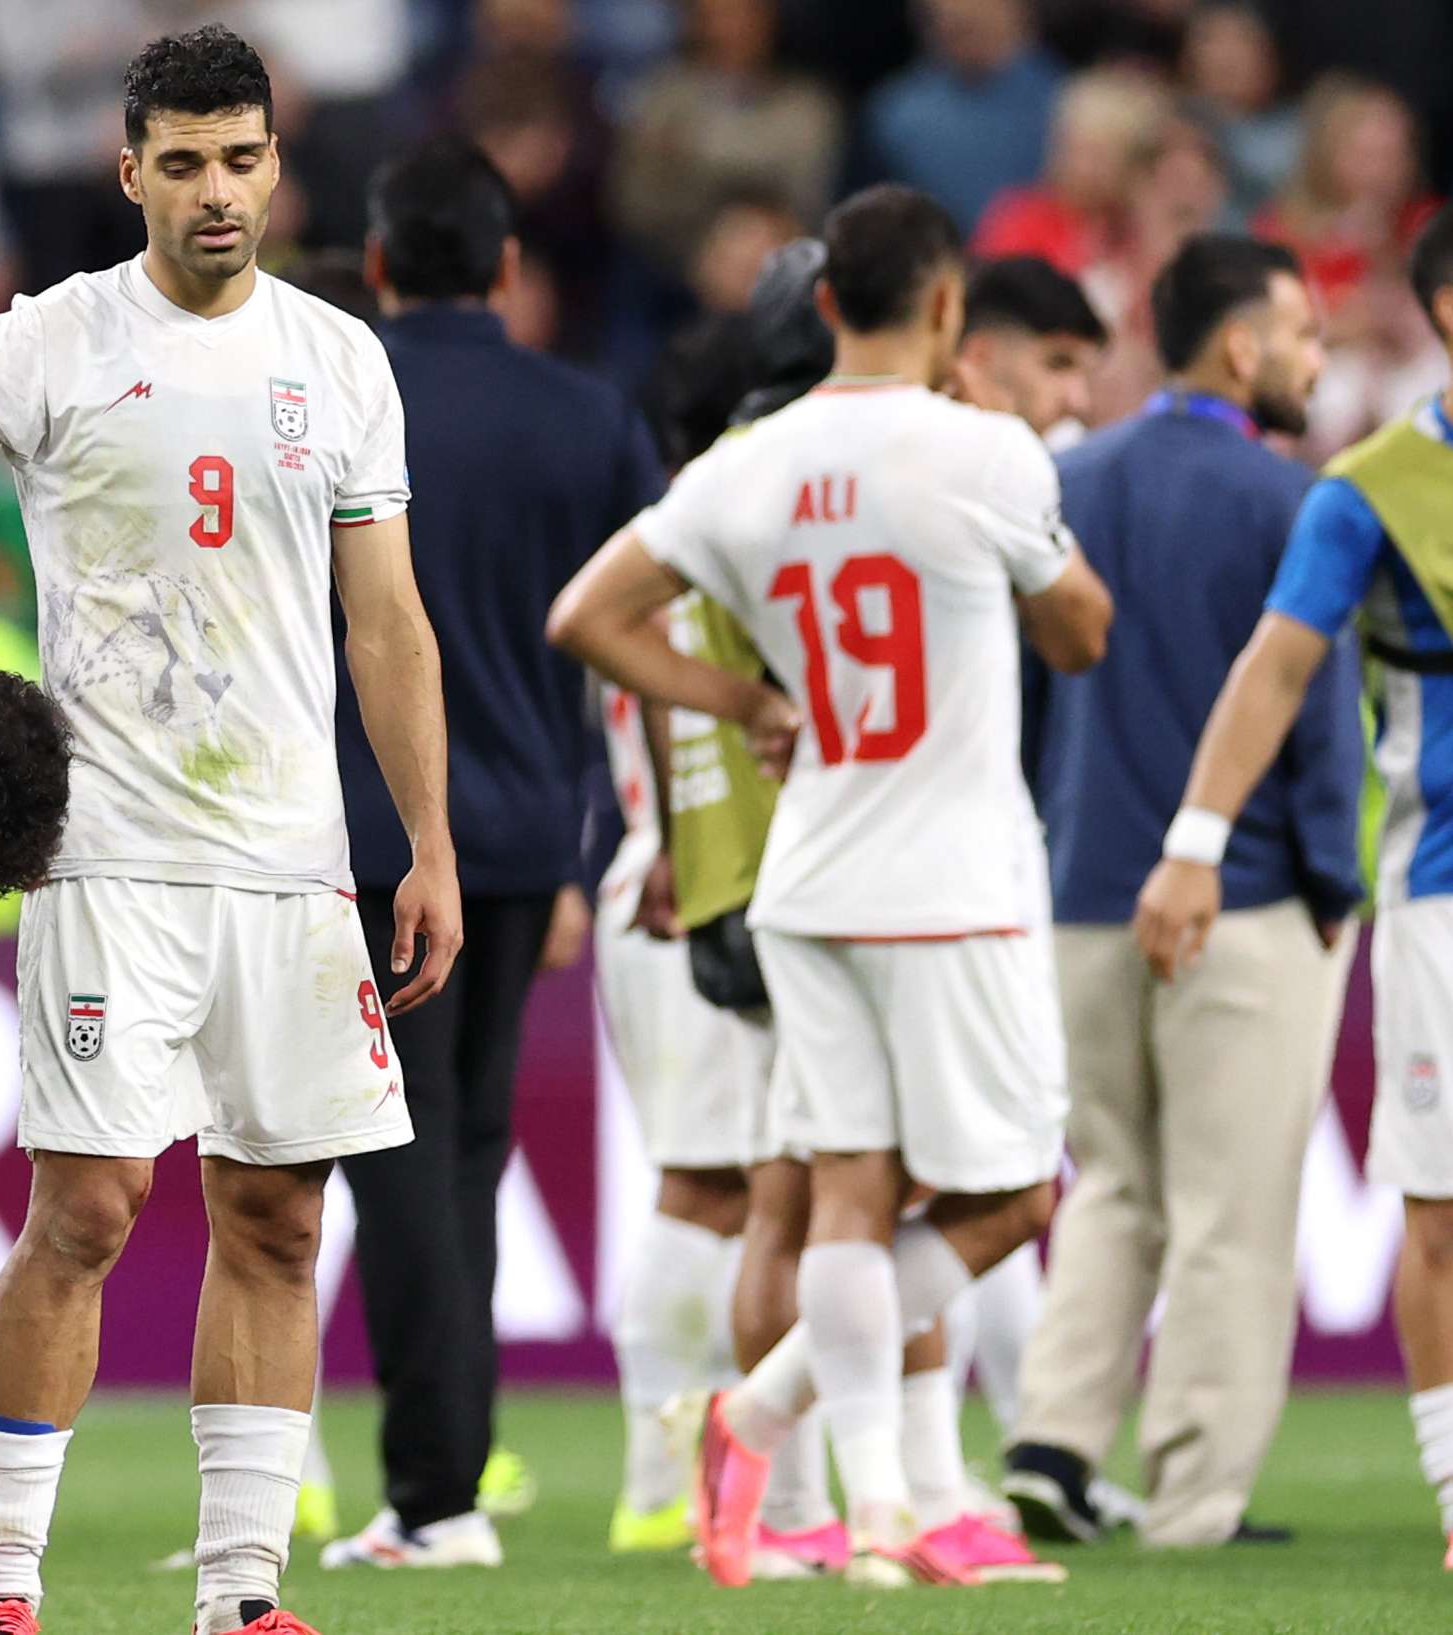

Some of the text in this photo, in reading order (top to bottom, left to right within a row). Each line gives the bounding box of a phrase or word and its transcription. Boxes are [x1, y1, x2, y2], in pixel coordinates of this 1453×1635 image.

[189, 456, 234, 548] 9
[791, 473, 858, 527] ALI
[766, 553, 929, 768] 19
[357, 980, 388, 1069] 9
